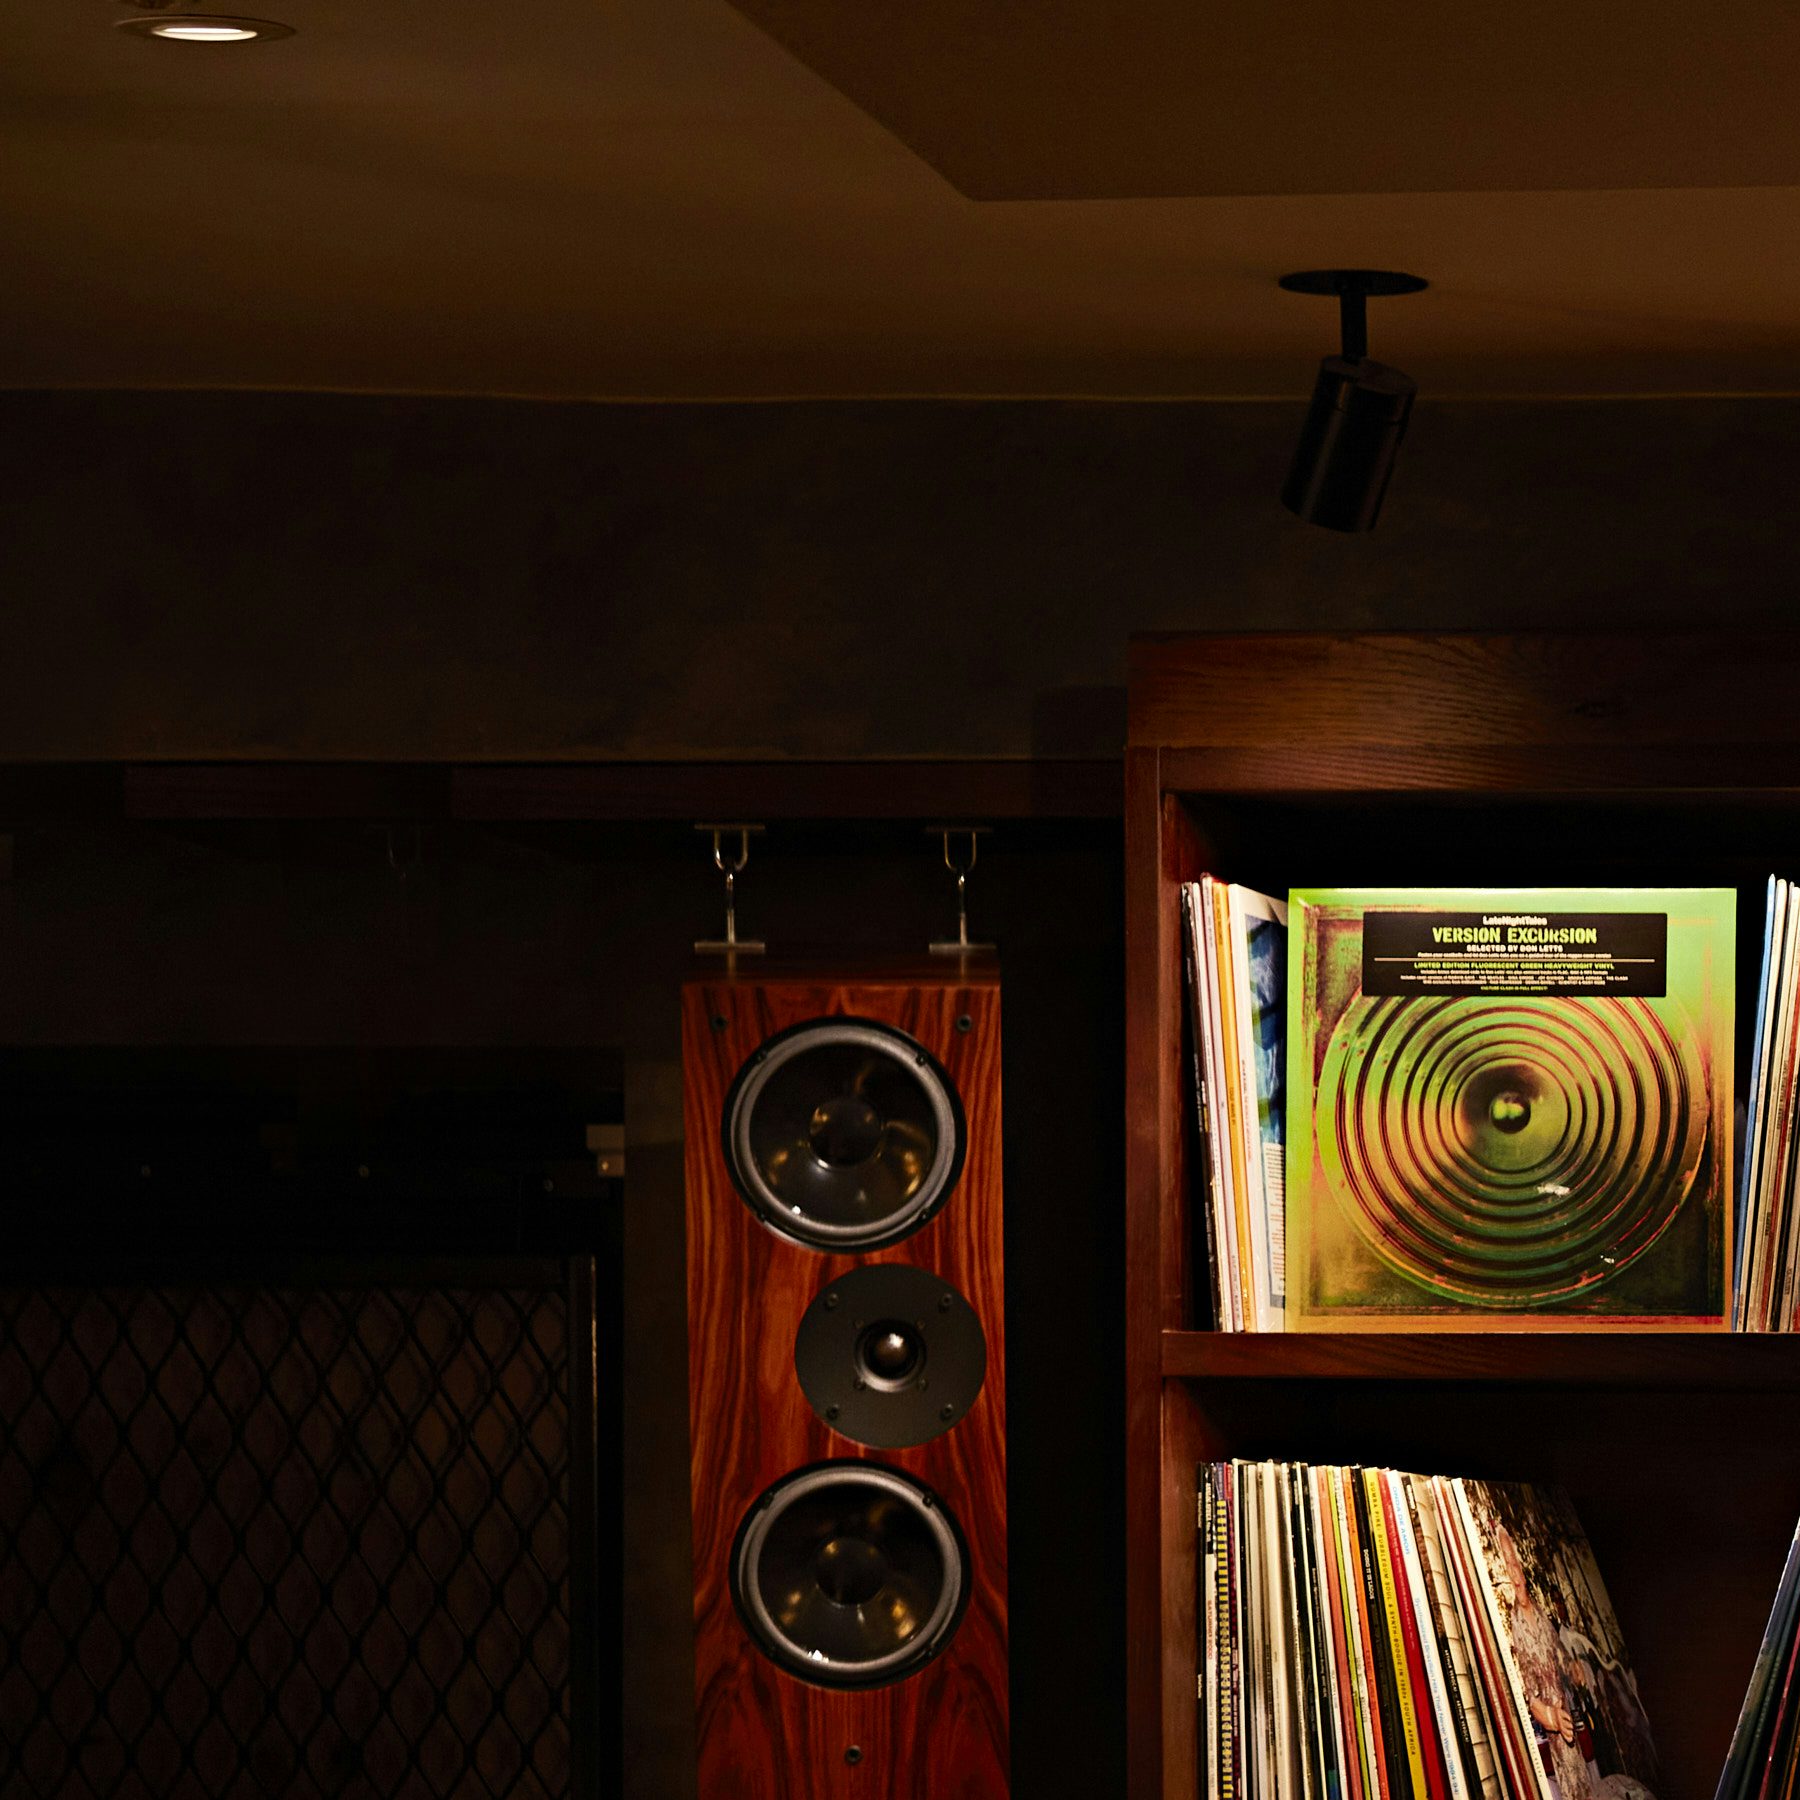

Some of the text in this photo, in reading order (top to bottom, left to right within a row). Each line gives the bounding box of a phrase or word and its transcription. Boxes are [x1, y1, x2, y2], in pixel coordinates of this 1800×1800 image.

[1432, 927, 1597, 944] VERSION EXCURSION
[1466, 944, 1563, 953] SELECTED BY DON LETTS
[1413, 962, 1614, 970] LIMITED EDITION FLUORESCENT GREEN HEAVYWEIGHT VINYL
[1397, 1514, 1405, 1525] DE
[1366, 1581, 1375, 1599] LAGOS
[1383, 1581, 1392, 1599] SOUL
[1402, 1702, 1412, 1726] SOUTH
[1406, 1729, 1416, 1755] AFRICA
